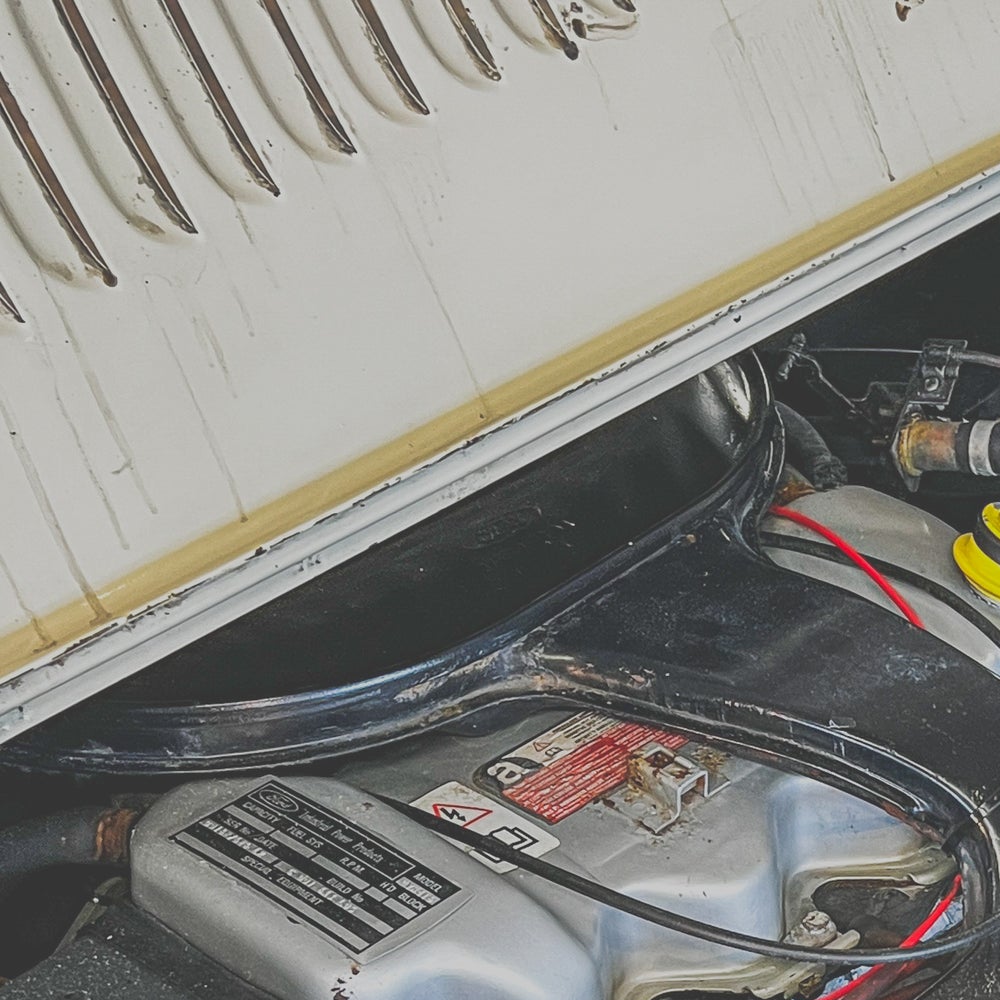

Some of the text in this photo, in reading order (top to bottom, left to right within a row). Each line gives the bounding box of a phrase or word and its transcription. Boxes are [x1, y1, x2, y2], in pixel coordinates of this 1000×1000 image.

[330, 829, 353, 844] Power
[352, 841, 384, 863] Products
[412, 873, 443, 894] MODEL
[398, 892, 427, 912] BLOCK
